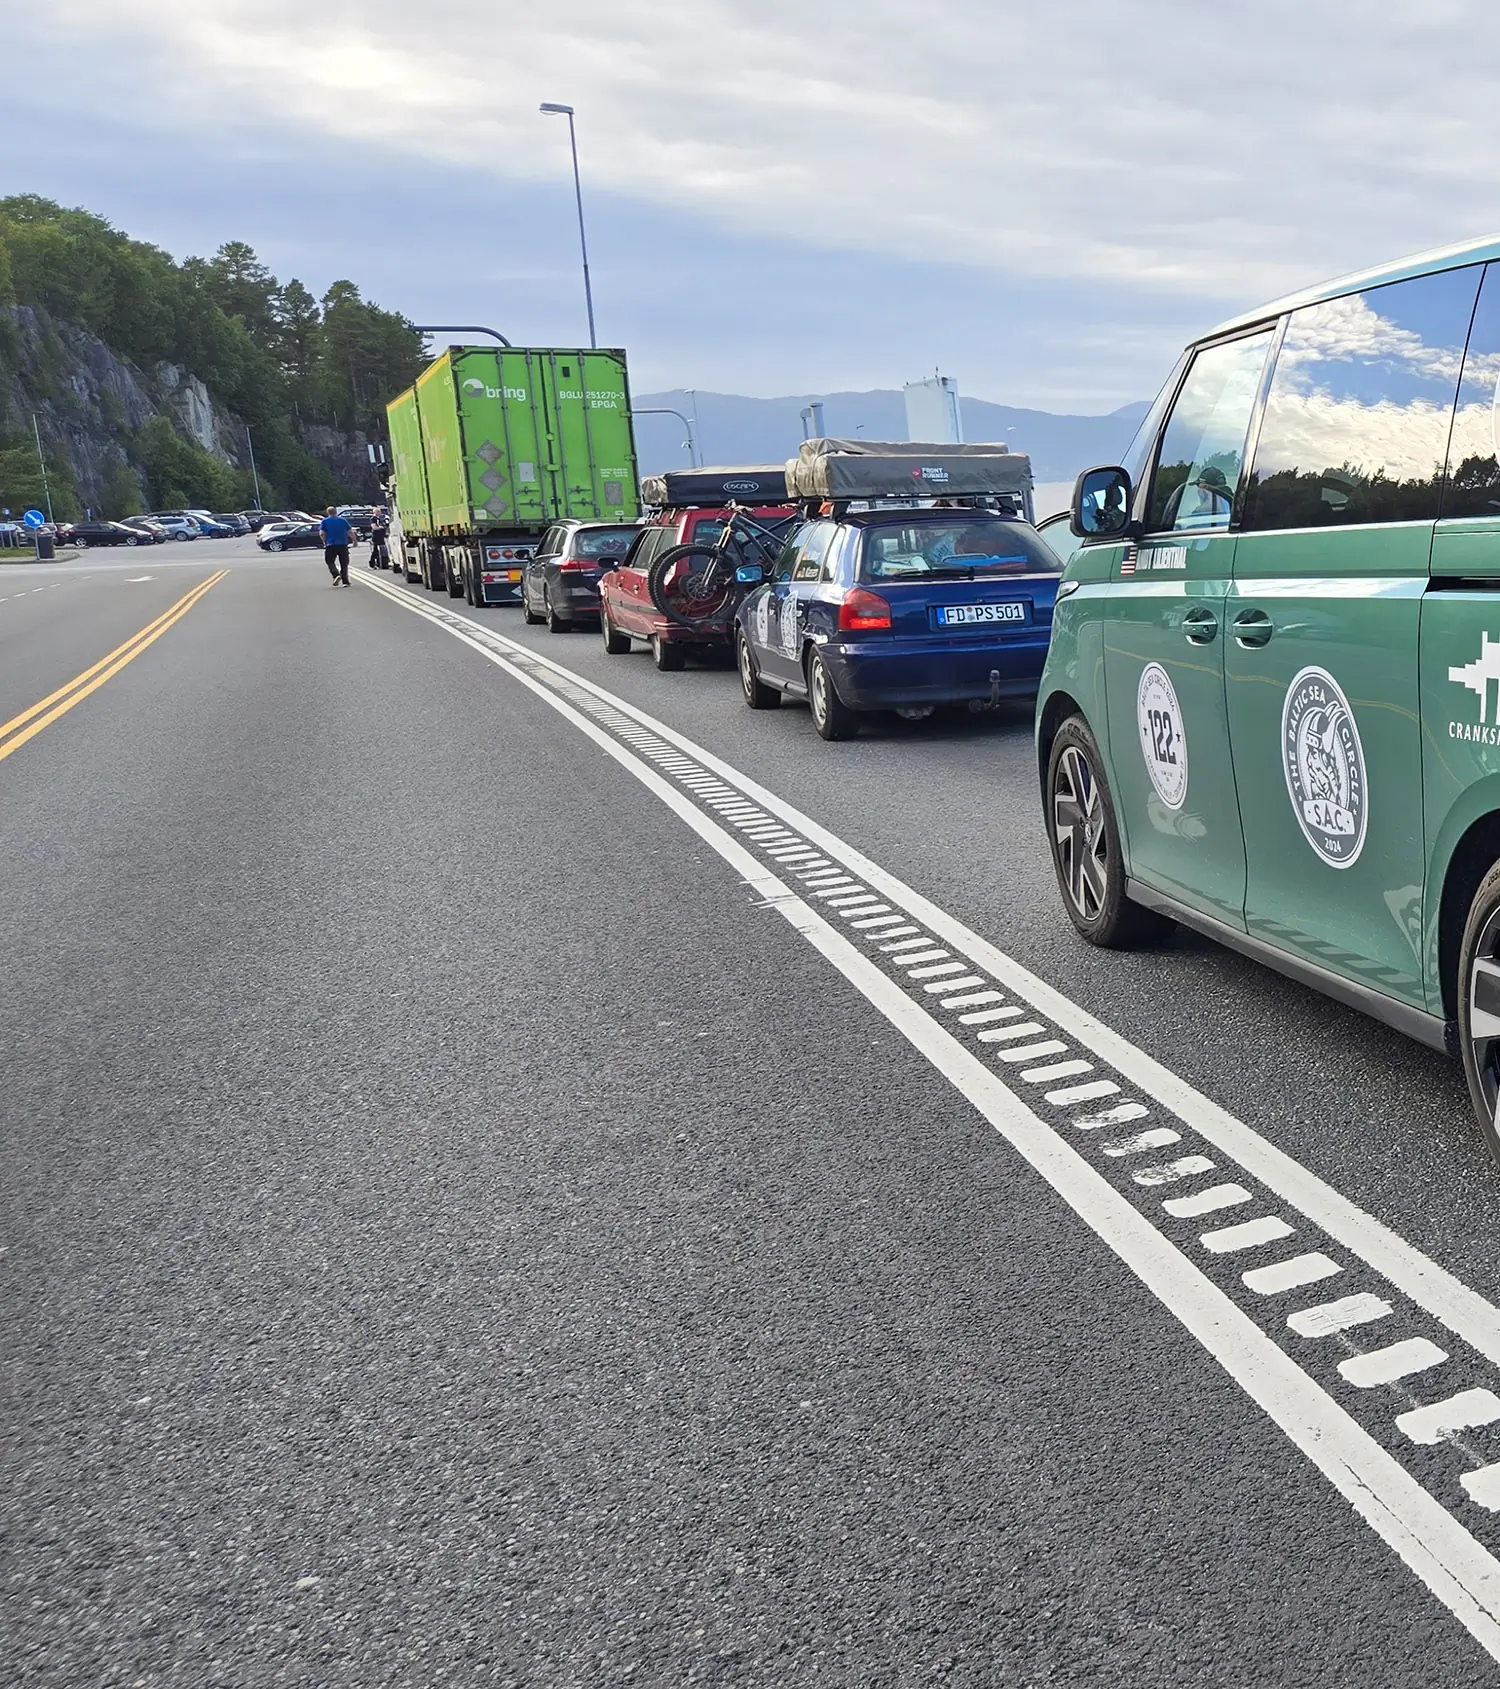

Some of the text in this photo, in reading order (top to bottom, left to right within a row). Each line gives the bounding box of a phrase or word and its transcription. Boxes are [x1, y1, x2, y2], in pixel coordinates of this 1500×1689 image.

[486, 385, 526, 401] bring
[946, 605, 1022, 622] FD PS 501
[1147, 709, 1177, 765] 122
[1288, 686, 1359, 805] THE BALTIC SEA CIRCLE
[1313, 804, 1347, 832] S.A.C.
[1324, 837, 1342, 852] 2024
